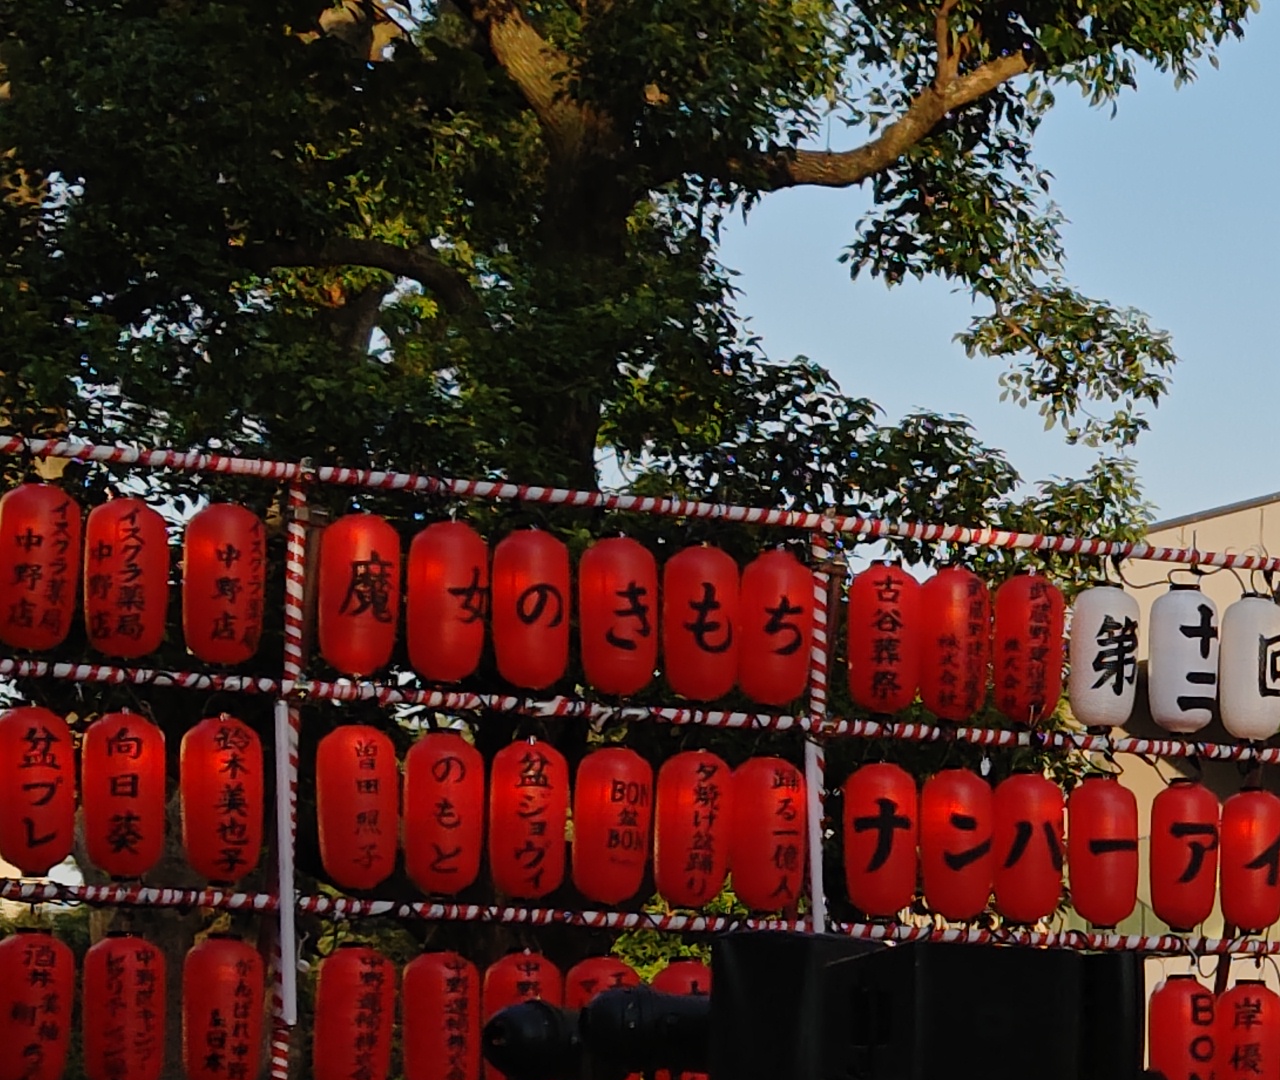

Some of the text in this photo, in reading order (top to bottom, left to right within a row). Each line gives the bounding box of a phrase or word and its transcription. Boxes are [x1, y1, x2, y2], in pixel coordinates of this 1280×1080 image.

[7, 527, 43, 629] 中野店
[117, 508, 146, 641] イスクラ薬局
[210, 543, 240, 641] 中野店
[338, 549, 805, 656] 魔女のきもち
[18, 726, 62, 848] 盆プレ
[106, 727, 143, 854] 向日葵
[214, 726, 250, 873] 鈴木美也子
[428, 756, 467, 877] のもと
